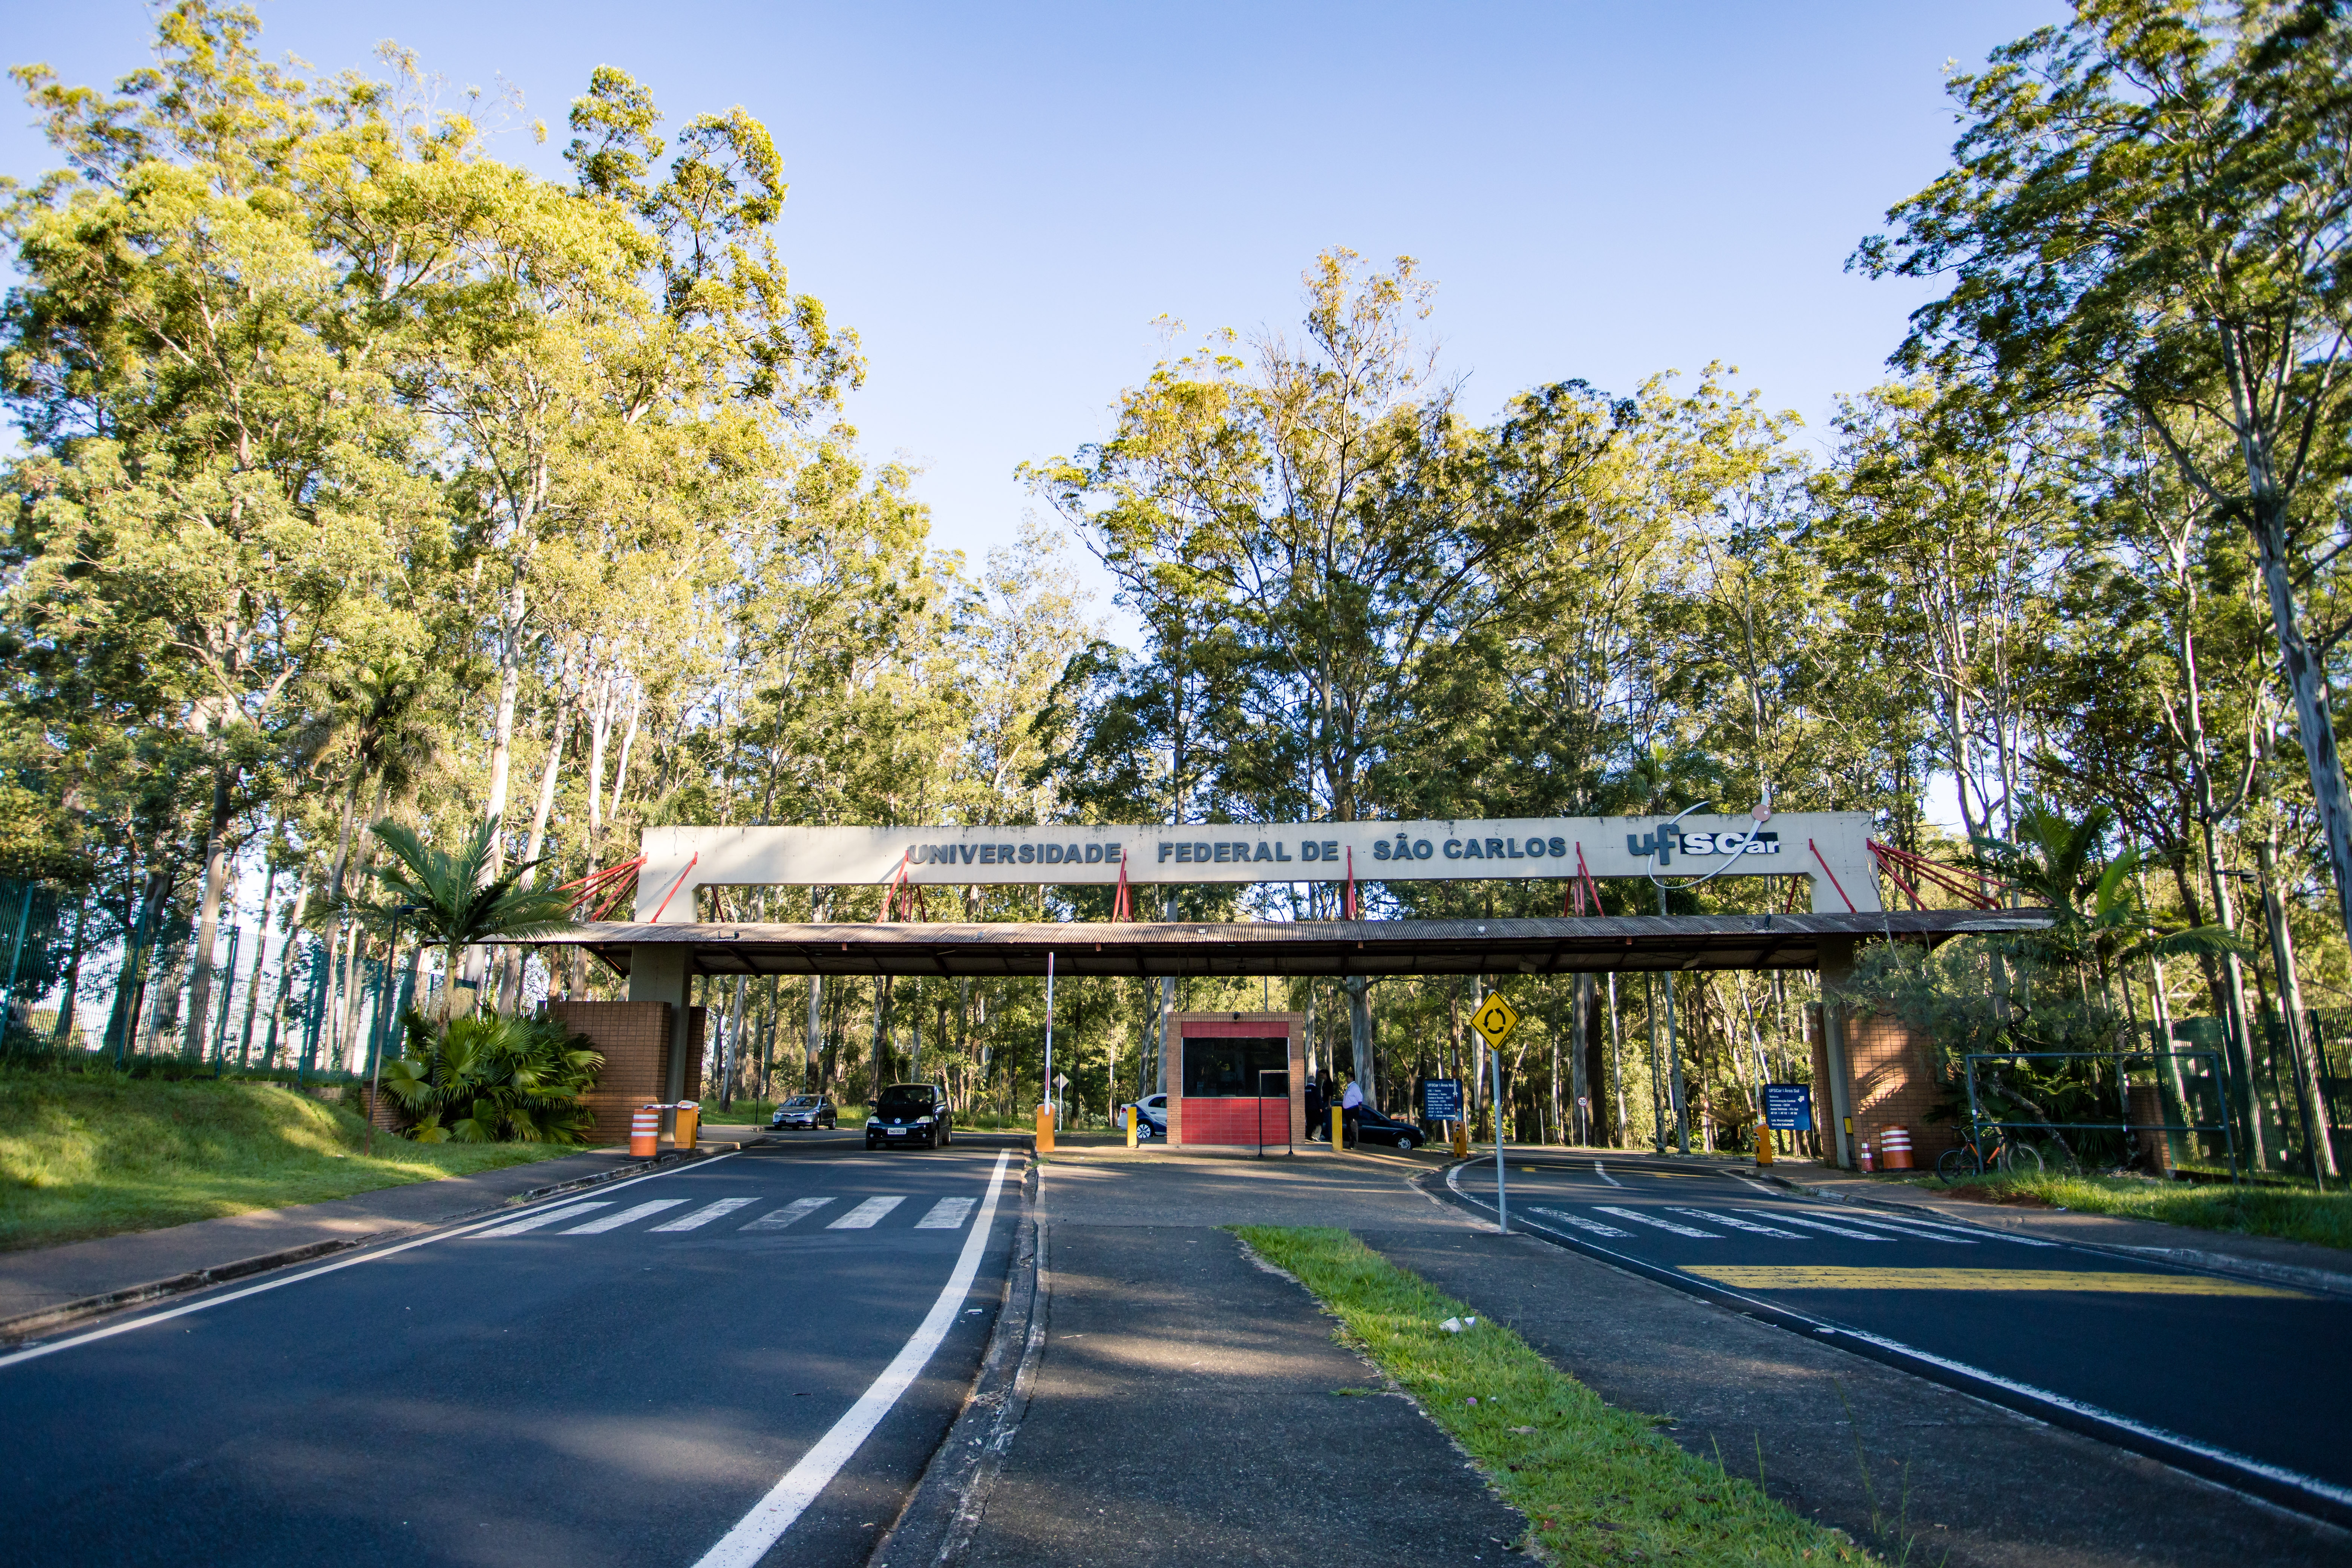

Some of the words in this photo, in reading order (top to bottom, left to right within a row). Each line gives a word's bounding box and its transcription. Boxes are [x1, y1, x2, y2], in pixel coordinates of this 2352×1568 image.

[907, 843, 1121, 864] UNIVERSIDADE
[1158, 841, 1291, 862] FEDERAL
[1302, 841, 1338, 861] DE
[1373, 833, 1433, 860] SÃO
[1443, 836, 1566, 859] CARLOS
